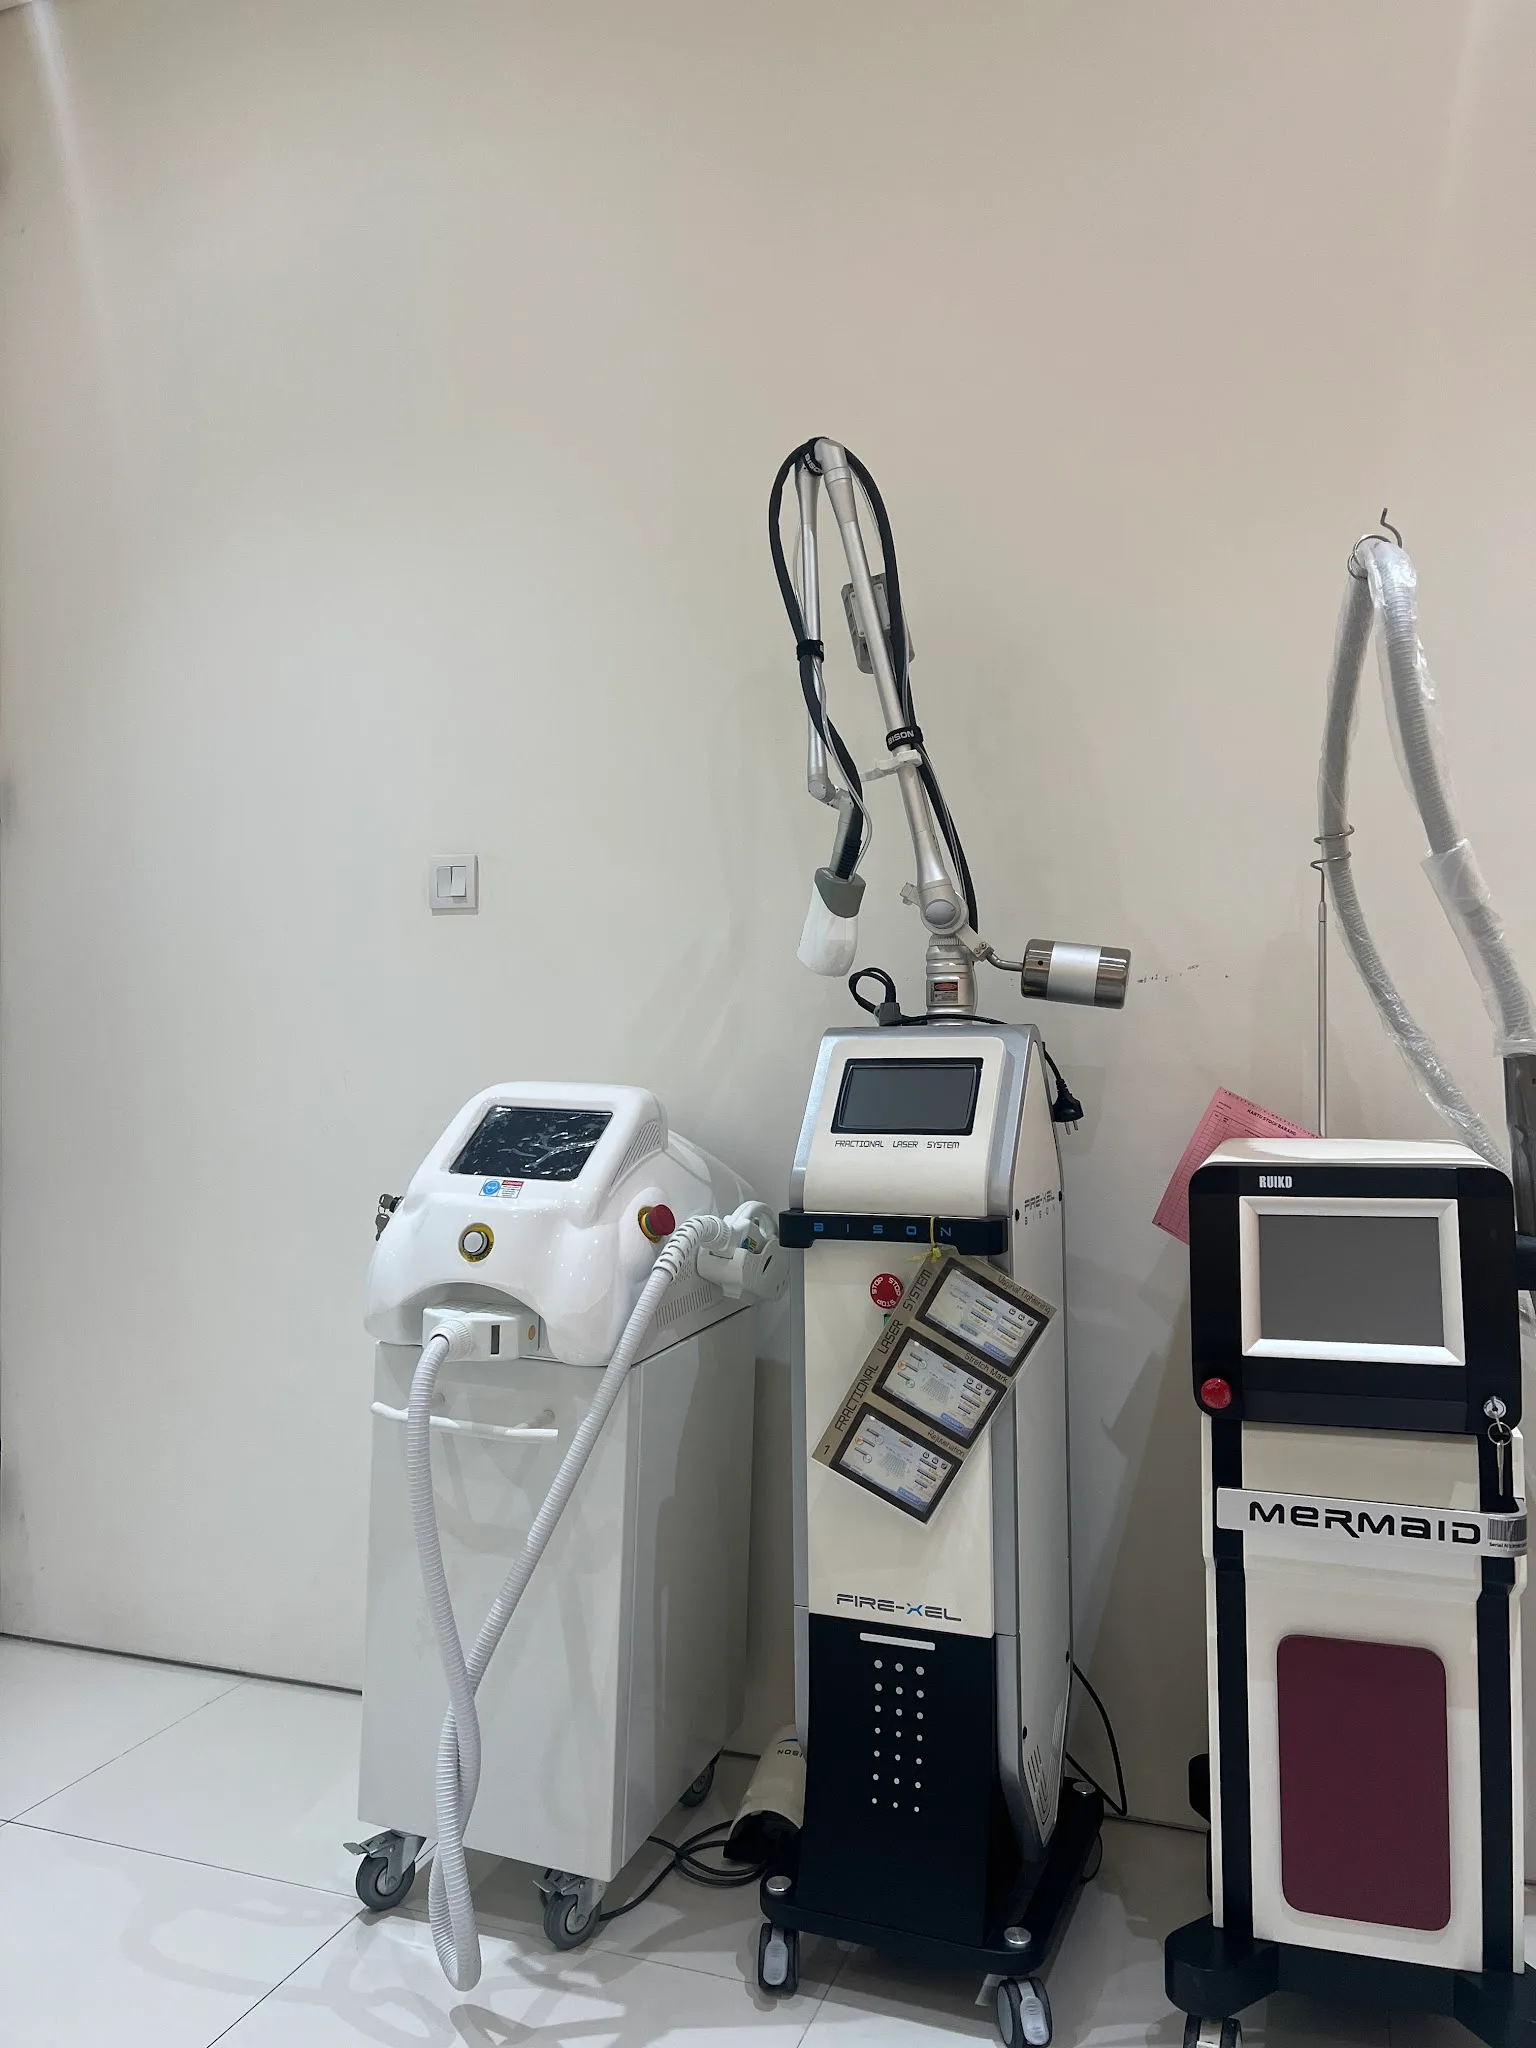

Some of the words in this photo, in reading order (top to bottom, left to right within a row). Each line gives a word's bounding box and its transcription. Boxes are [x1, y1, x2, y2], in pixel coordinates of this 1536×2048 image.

[804, 453, 822, 474] BISO
[888, 730, 915, 745] BISON
[834, 1140, 884, 1148] FRACTIONAL
[926, 1141, 960, 1149] SYSTEM
[813, 1222, 952, 1237] BISON
[871, 1276, 884, 1295] STOP
[888, 1277, 901, 1297] STOP
[876, 1299, 896, 1307] STOP
[834, 1365, 879, 1432] FRACTIONAL
[877, 1319, 903, 1355] LASER
[902, 1269, 932, 1312] SYSTEM
[964, 1352, 989, 1373] Stretch
[989, 1367, 1009, 1384] Mark
[927, 1428, 965, 1457] Rejuvenation
[836, 1593, 962, 1622] FIRE-XEL
[777, 1749, 803, 1758] ISON
